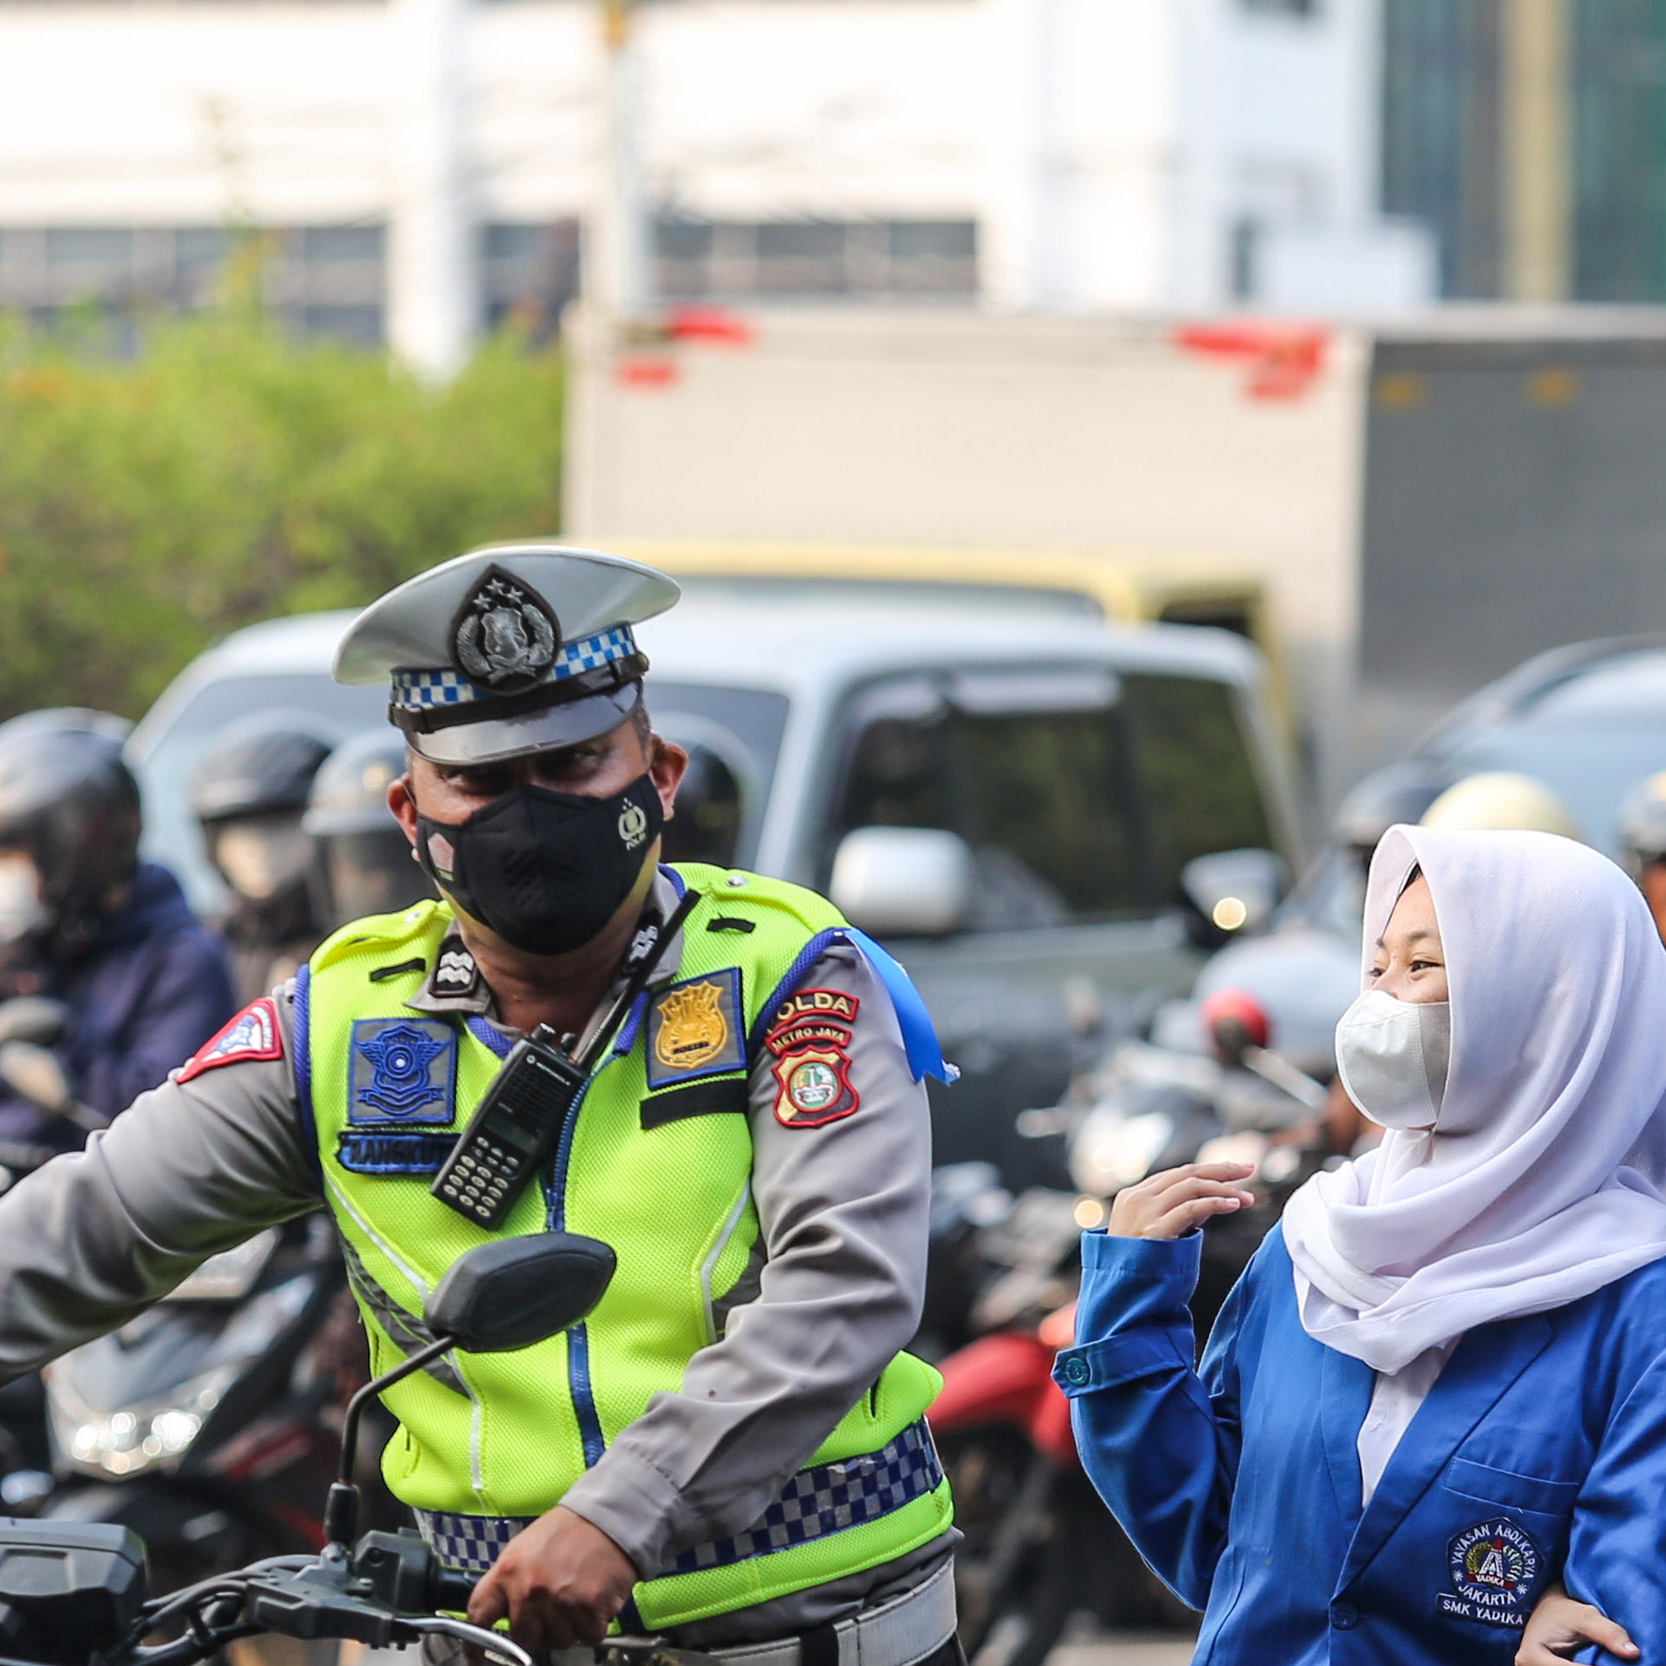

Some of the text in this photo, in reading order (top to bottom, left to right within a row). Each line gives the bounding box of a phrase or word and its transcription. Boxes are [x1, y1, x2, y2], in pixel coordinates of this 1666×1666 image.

[770, 992, 851, 1028] OLDA
[771, 1027, 846, 1051] METRO JAYA
[1451, 1524, 1536, 1579] YAYASAN ABOLKARYA
[1475, 1574, 1505, 1587] YADIKA
[1458, 1584, 1518, 1606] JAKARTA
[1443, 1599, 1524, 1625] SMK YADIKA
